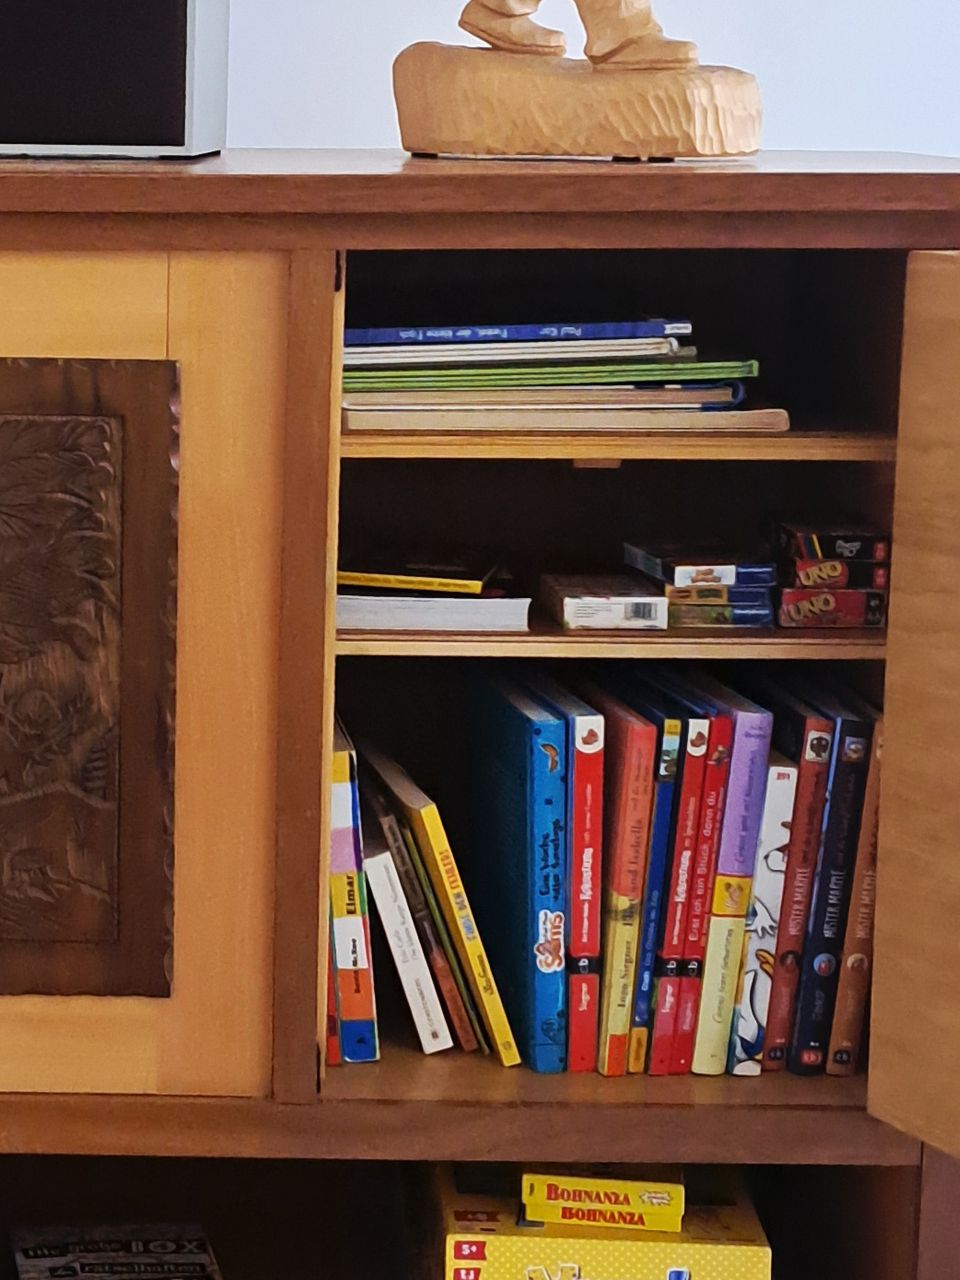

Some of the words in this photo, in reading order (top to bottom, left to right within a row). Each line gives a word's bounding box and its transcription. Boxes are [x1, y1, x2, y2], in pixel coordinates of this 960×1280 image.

[798, 561, 842, 586] UNO
[790, 593, 836, 620] UNO
[345, 874, 357, 915] Elmar
[793, 867, 811, 901] MARPLE
[828, 869, 845, 904] MARPLE
[789, 903, 804, 936] MISTER
[823, 906, 839, 938] MISTER
[546, 1183, 630, 1206] BOHNANZA
[561, 1206, 645, 1225] BOHNANZA
[132, 1241, 200, 1252] BOX
